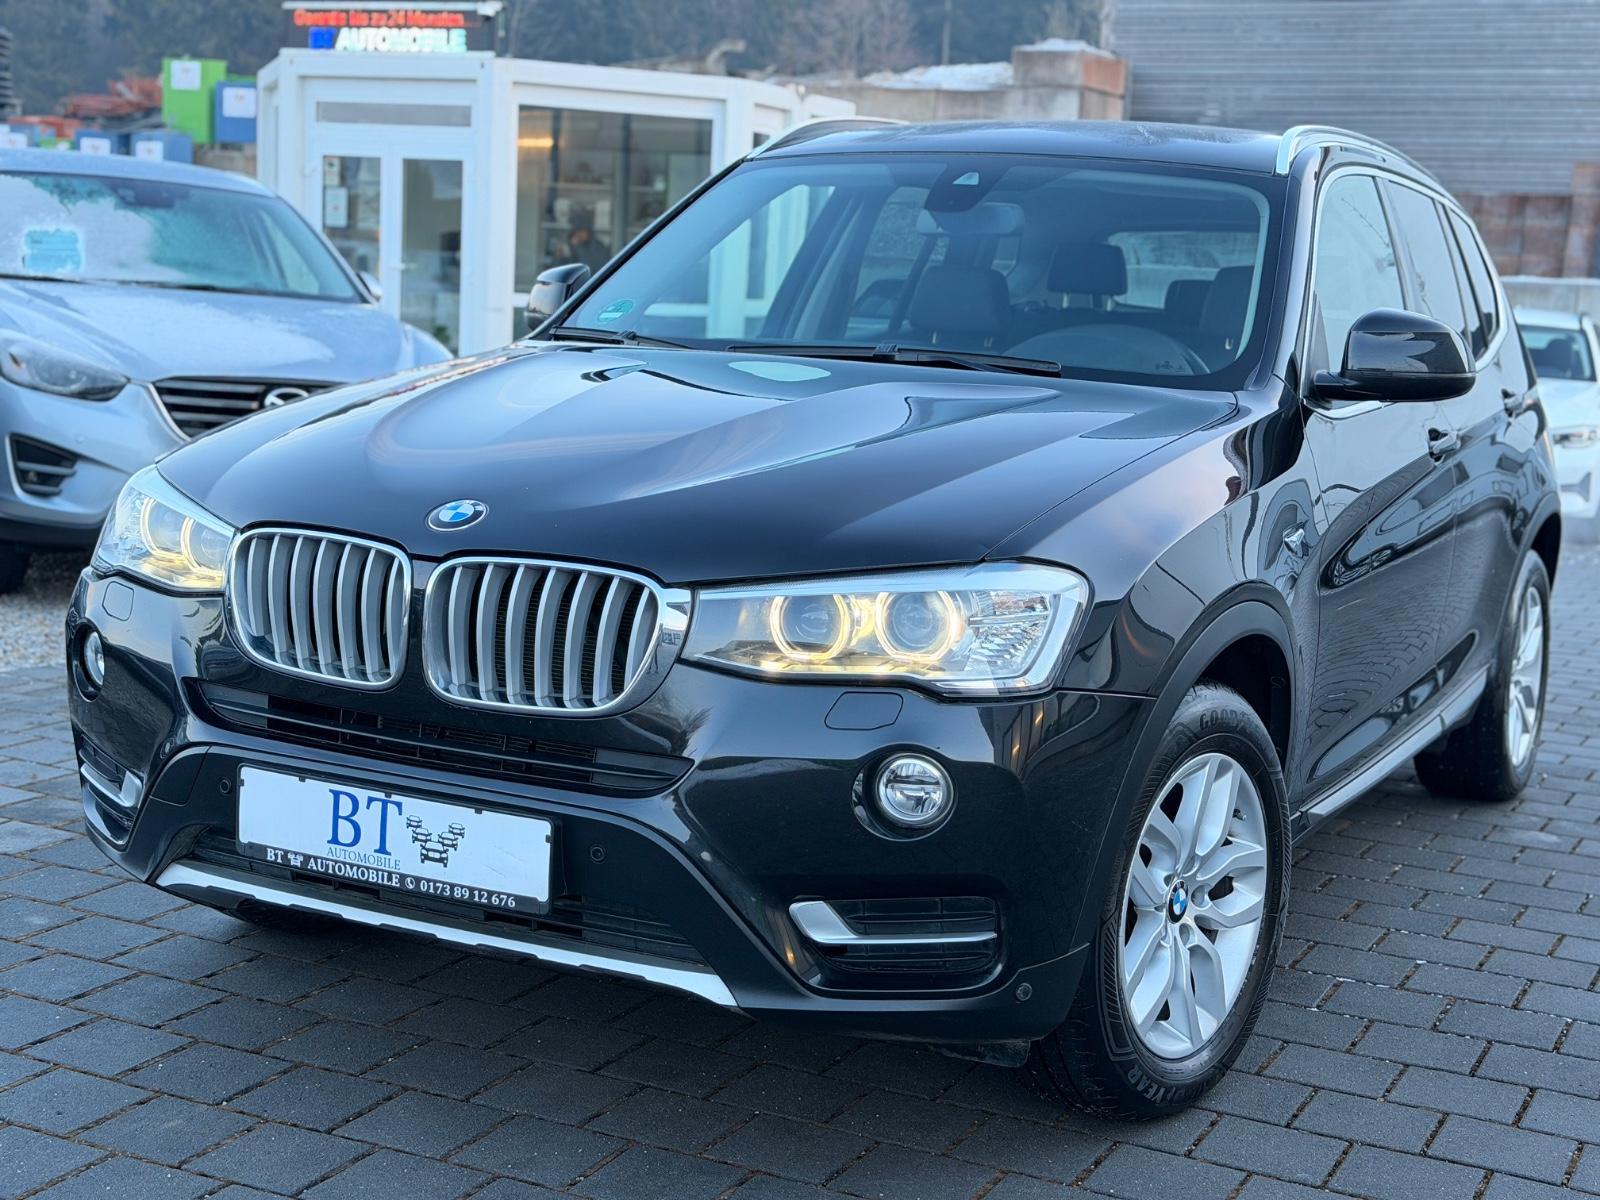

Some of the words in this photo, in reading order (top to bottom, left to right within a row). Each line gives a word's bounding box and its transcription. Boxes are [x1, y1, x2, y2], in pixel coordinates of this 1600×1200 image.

[334, 27, 467, 52] AUTOMOBILE
[326, 788, 403, 856] BT
[266, 847, 284, 863] BT
[307, 857, 400, 887] AUTOMOBILE
[420, 879, 451, 896] 0173
[453, 886, 470, 899] 89
[473, 890, 488, 903] 12
[491, 893, 516, 908] 676
[326, 846, 401, 871] AUTOMOBILE
